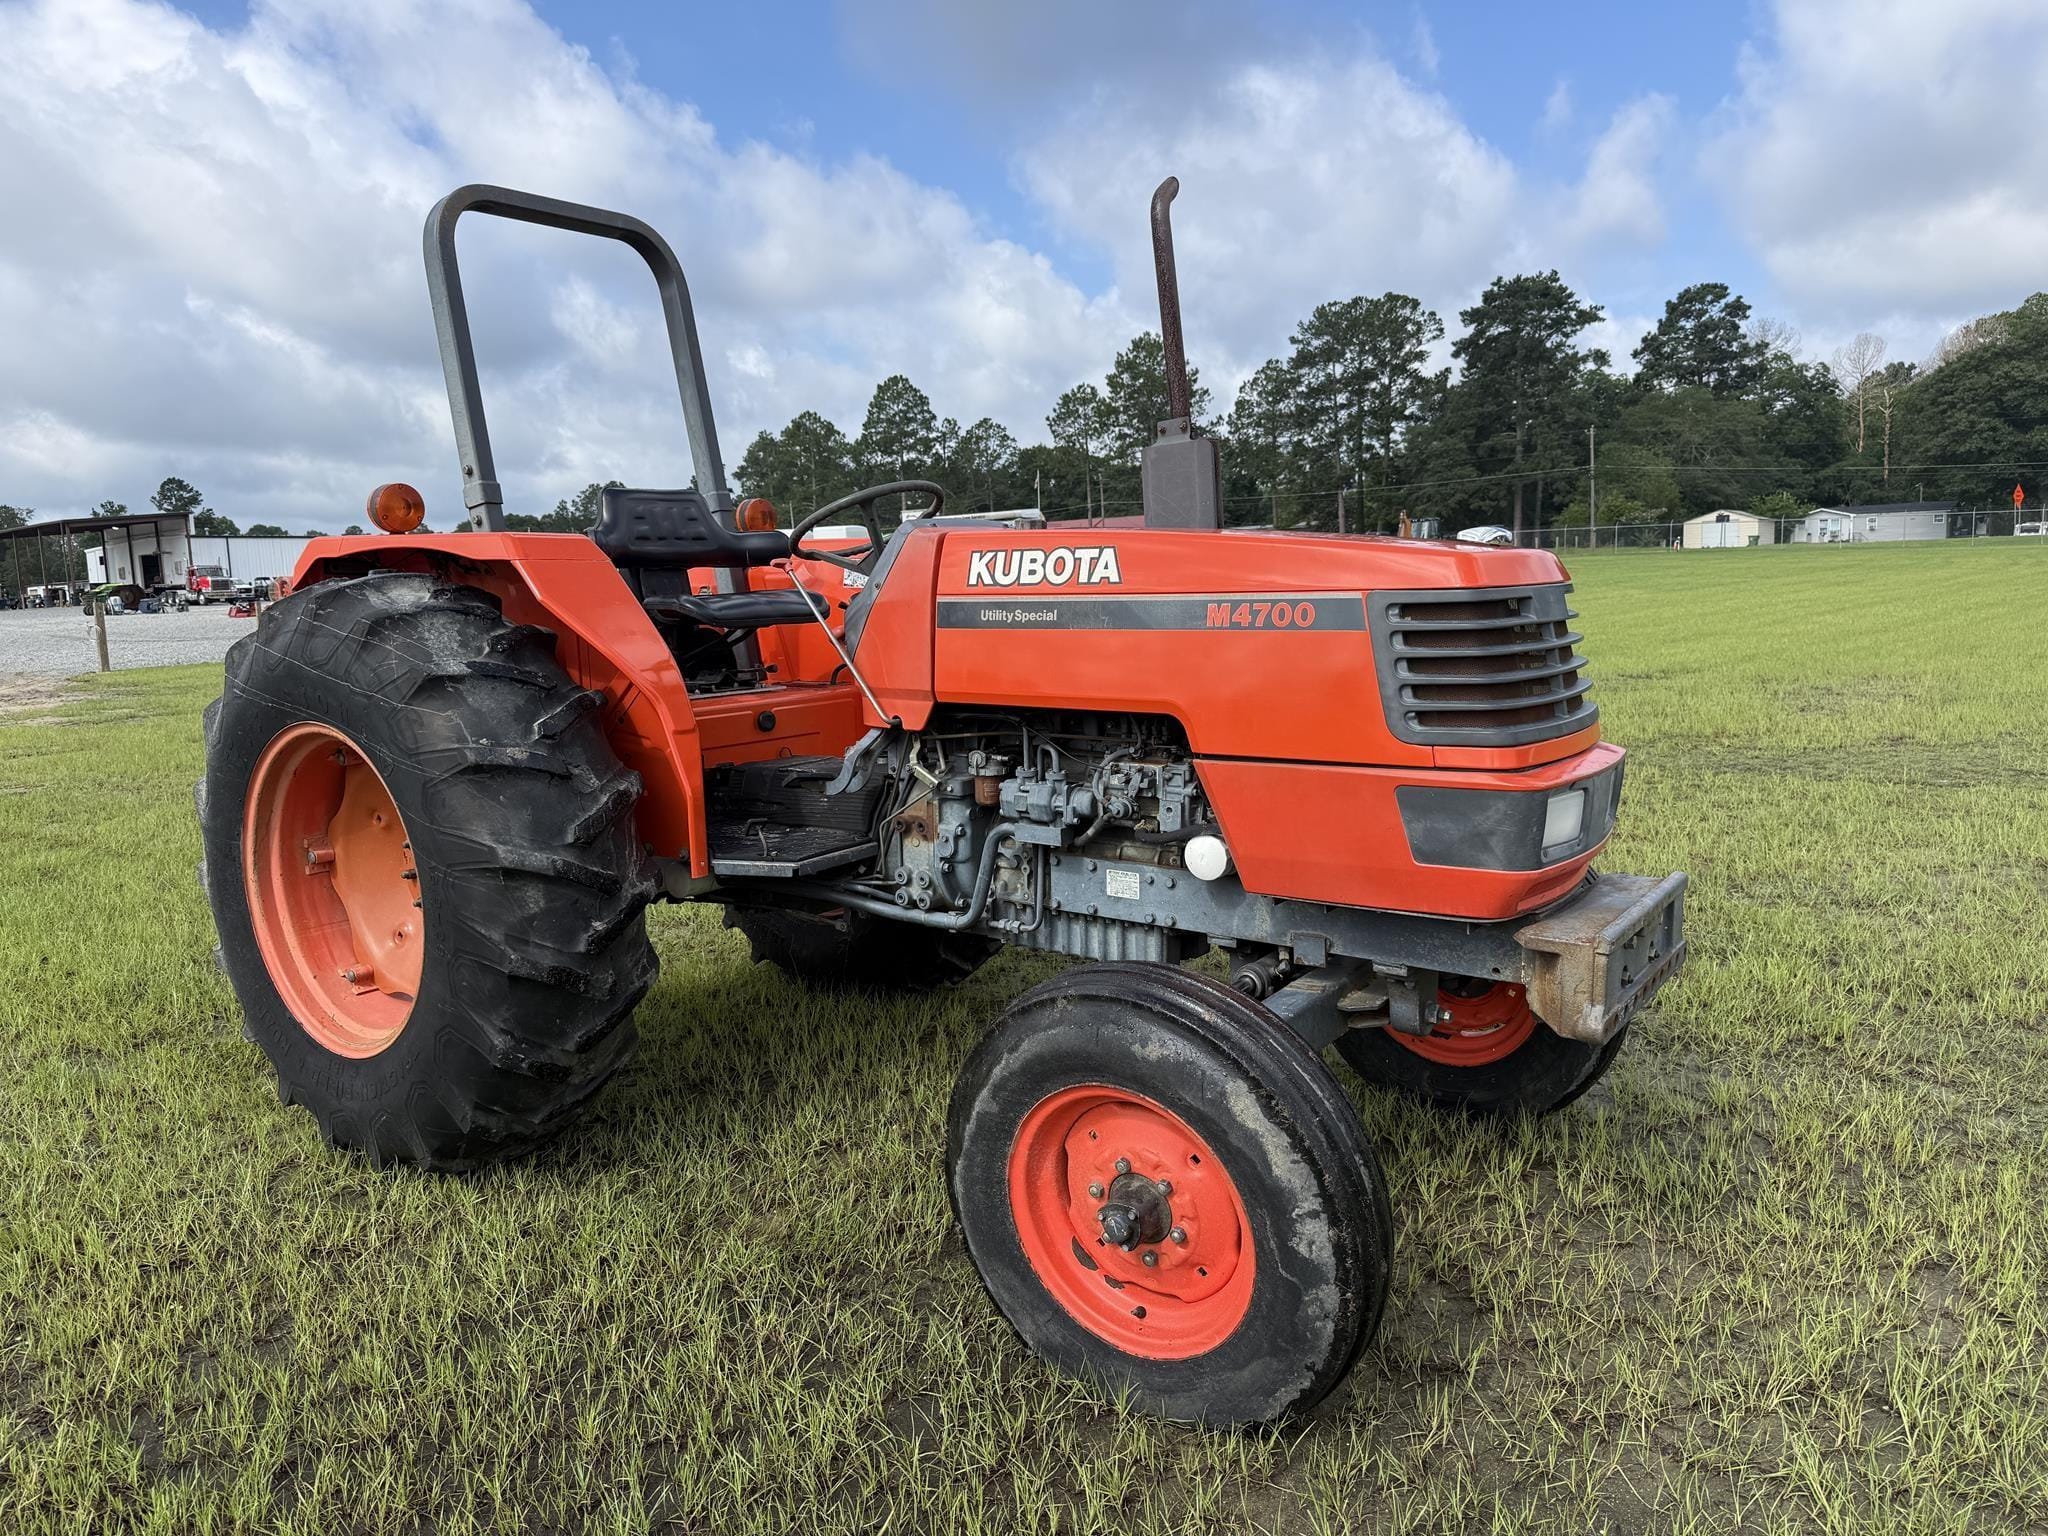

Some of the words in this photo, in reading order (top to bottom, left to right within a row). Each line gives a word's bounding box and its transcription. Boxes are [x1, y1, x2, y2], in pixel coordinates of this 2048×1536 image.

[967, 545, 1122, 586] KUBOTA
[980, 609, 1014, 623] Utility
[1014, 609, 1058, 623] Special
[1206, 601, 1316, 628] M4700
